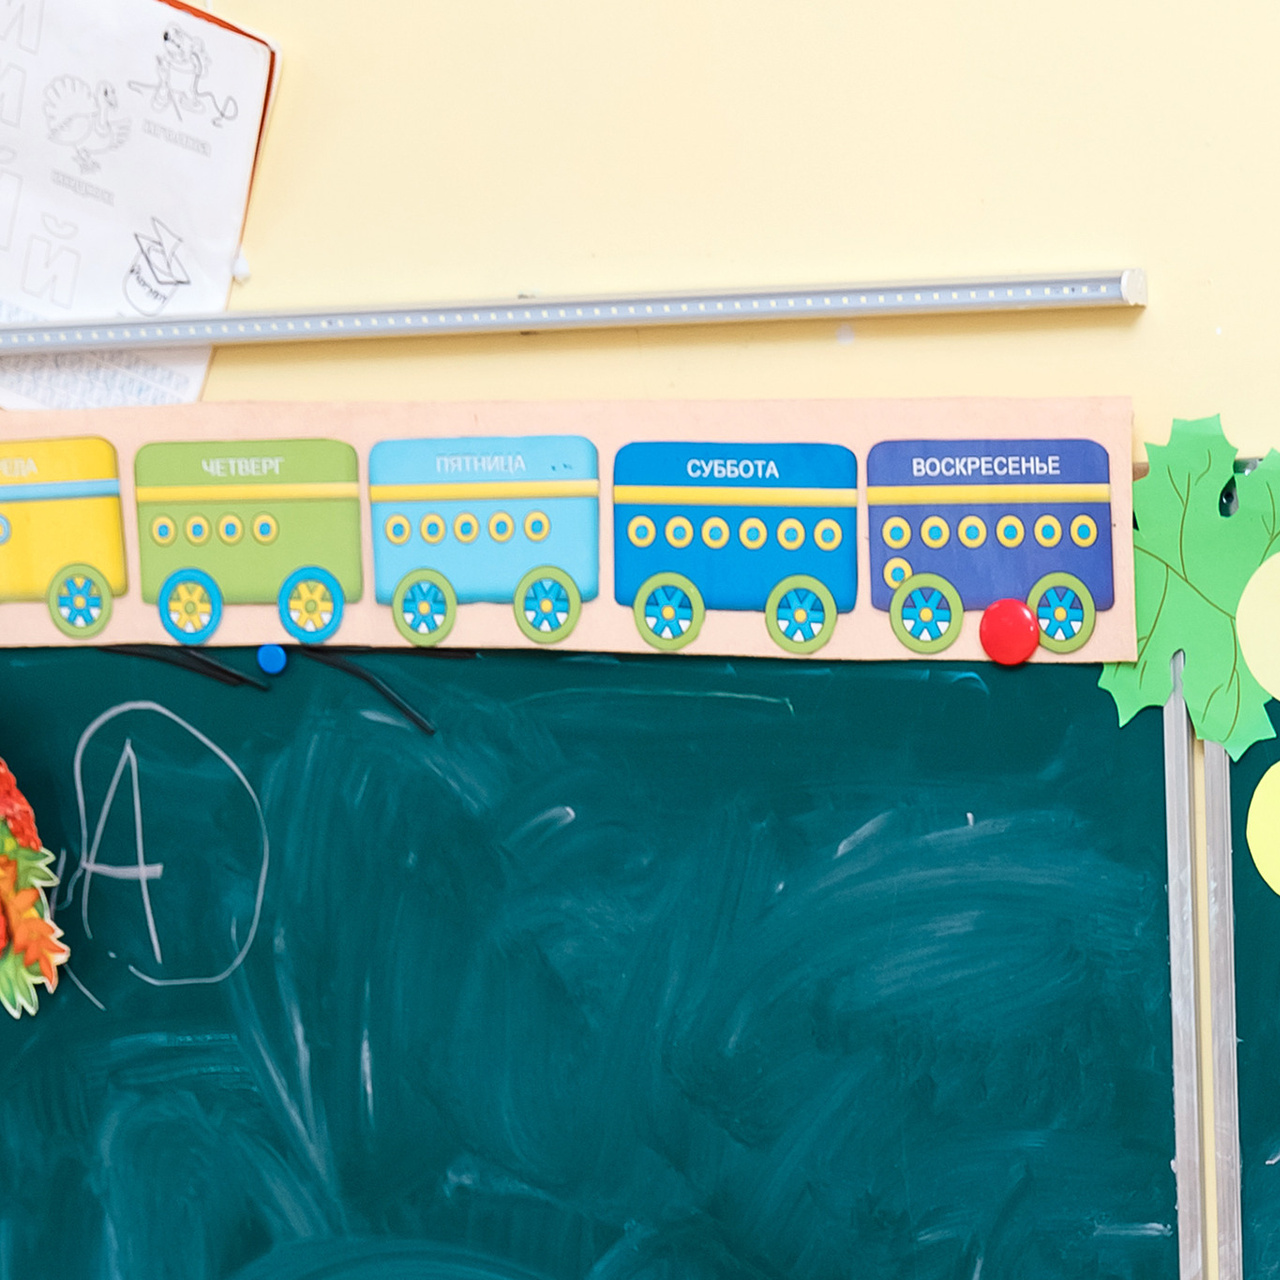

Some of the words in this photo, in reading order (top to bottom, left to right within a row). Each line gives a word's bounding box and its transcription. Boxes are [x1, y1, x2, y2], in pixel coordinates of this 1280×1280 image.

[201, 456, 285, 477] ЧЕТВЕРГ
[435, 454, 526, 475] ПЯТНИЦА
[686, 458, 780, 479] СУББОТА
[911, 455, 1061, 477] ВОСКРЕСЕНЬЕ
